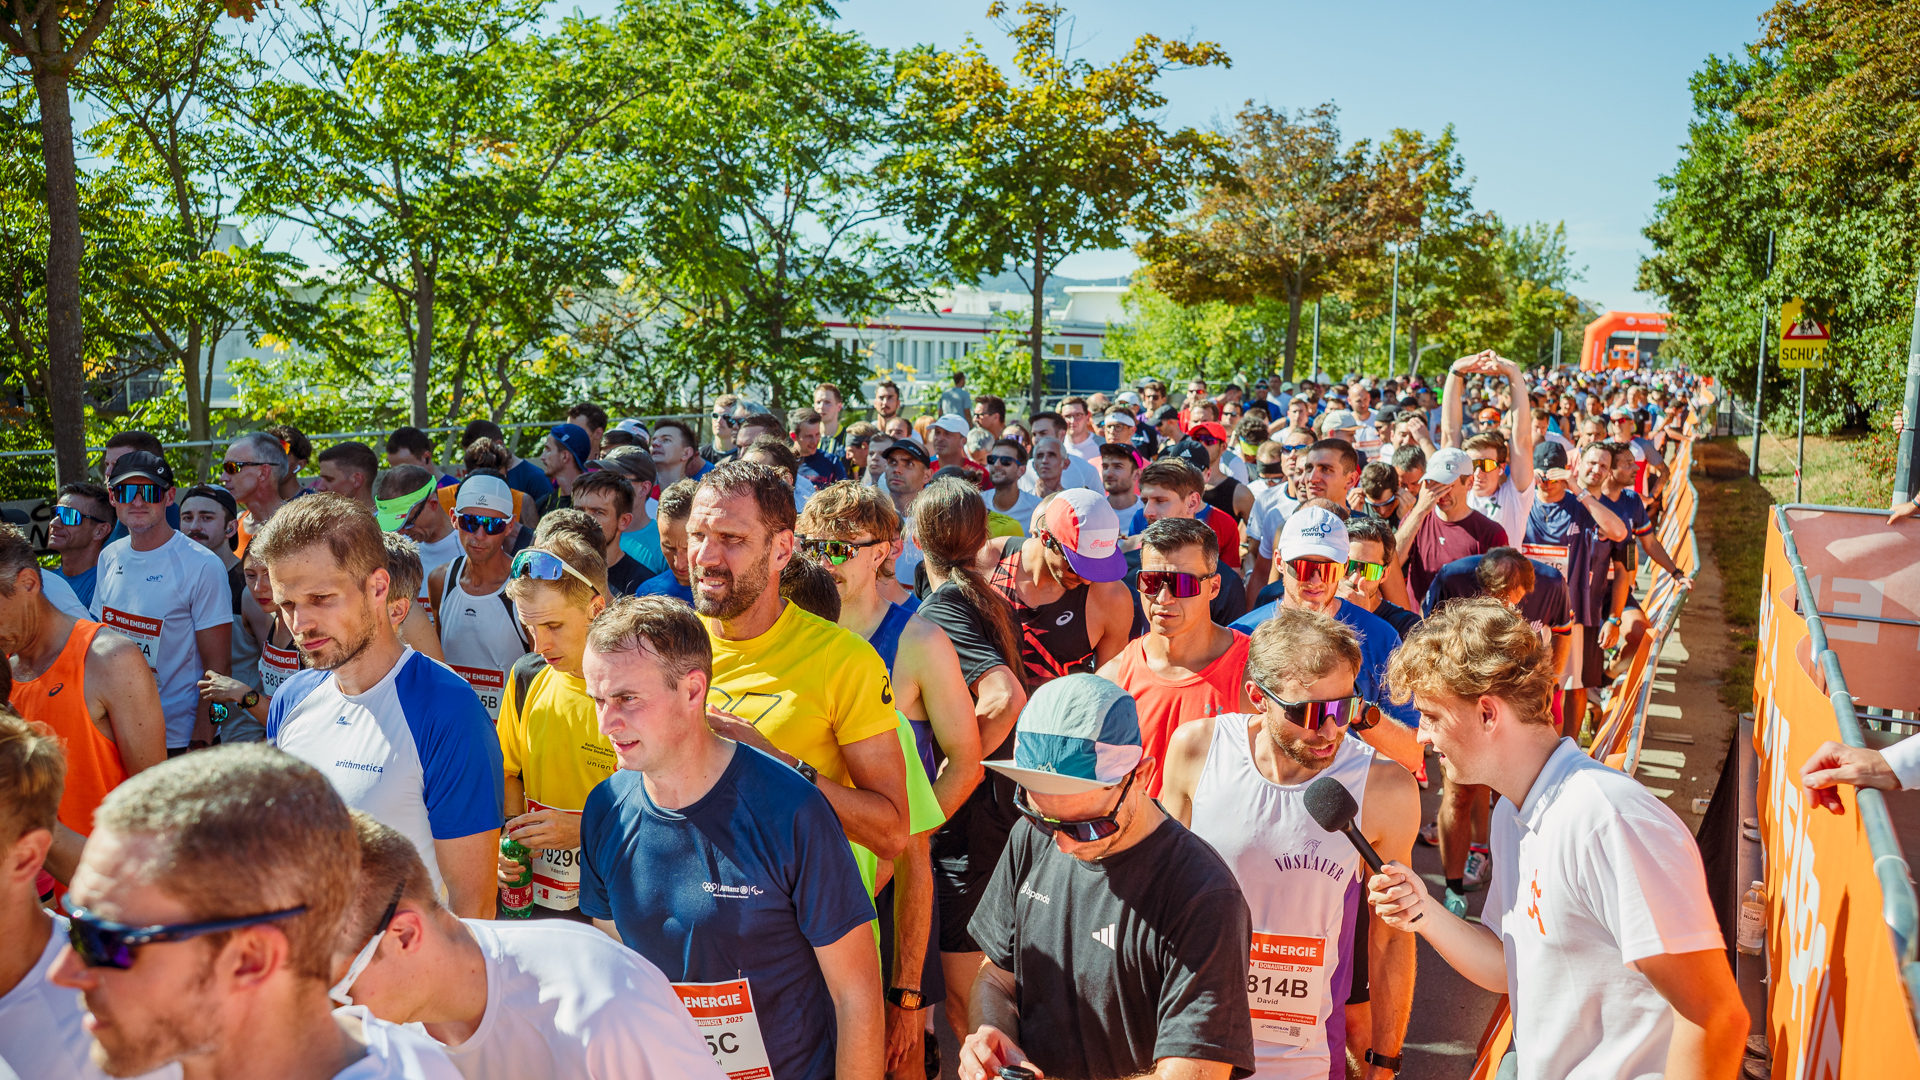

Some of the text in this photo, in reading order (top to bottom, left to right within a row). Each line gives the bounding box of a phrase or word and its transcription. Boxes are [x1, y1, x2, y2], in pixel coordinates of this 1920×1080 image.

[1301, 525, 1319, 533] world
[115, 614, 158, 632] WIEN ENERGIE
[273, 654, 297, 665] ENERGIE
[472, 674, 500, 683] ENERGIE
[479, 696, 498, 709] 5B
[335, 759, 384, 774] arithmetica
[586, 760, 611, 770] union
[550, 866, 569, 876] Valentin
[1274, 852, 1344, 882] VÖSLAUER
[720, 885, 740, 893] Allianz
[1262, 944, 1317, 957] ENERGIE
[1259, 962, 1293, 971] DONAUINSEL
[683, 993, 742, 1008] ENERGIE
[1257, 997, 1279, 1005] David
[725, 1016, 744, 1024] 2025
